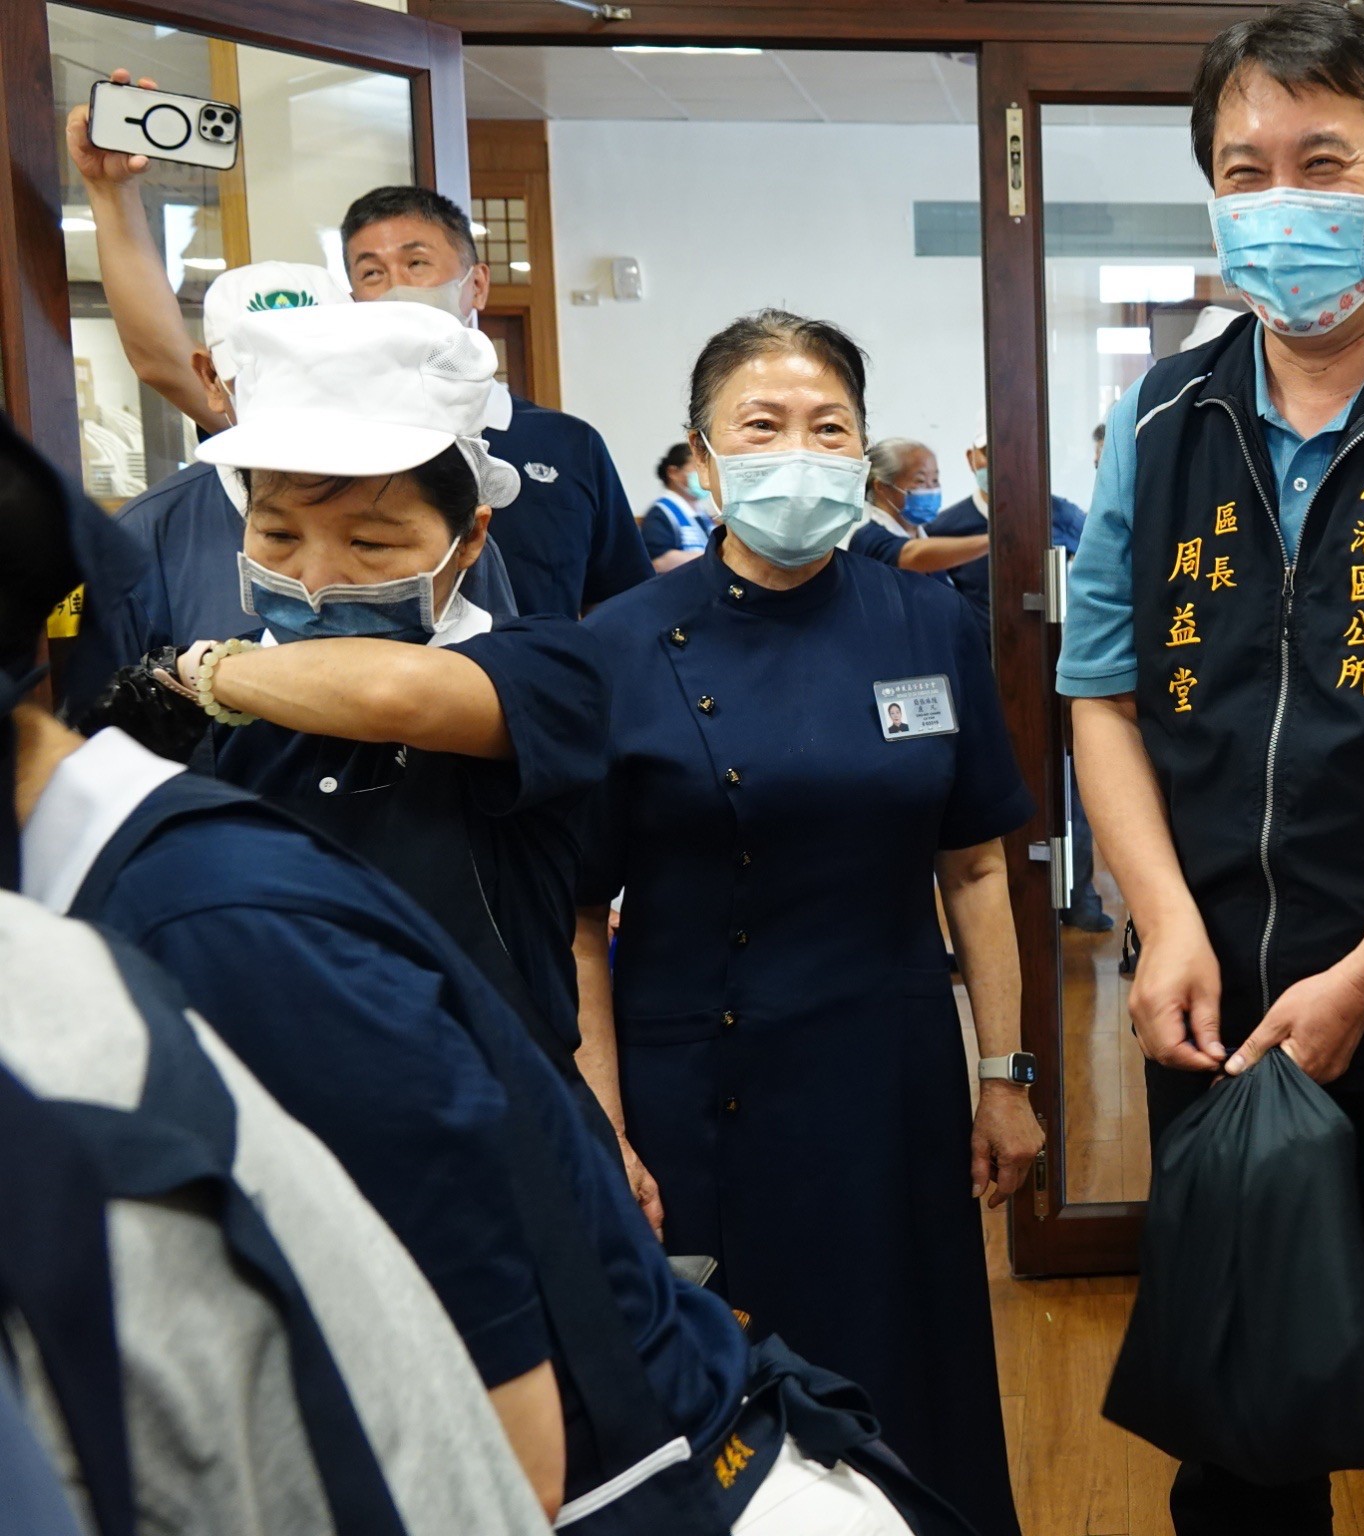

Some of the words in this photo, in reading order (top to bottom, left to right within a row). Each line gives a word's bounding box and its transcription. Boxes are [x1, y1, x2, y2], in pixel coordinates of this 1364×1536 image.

[1205, 501, 1239, 592] 區長
[1165, 537, 1203, 713] 周益堂
